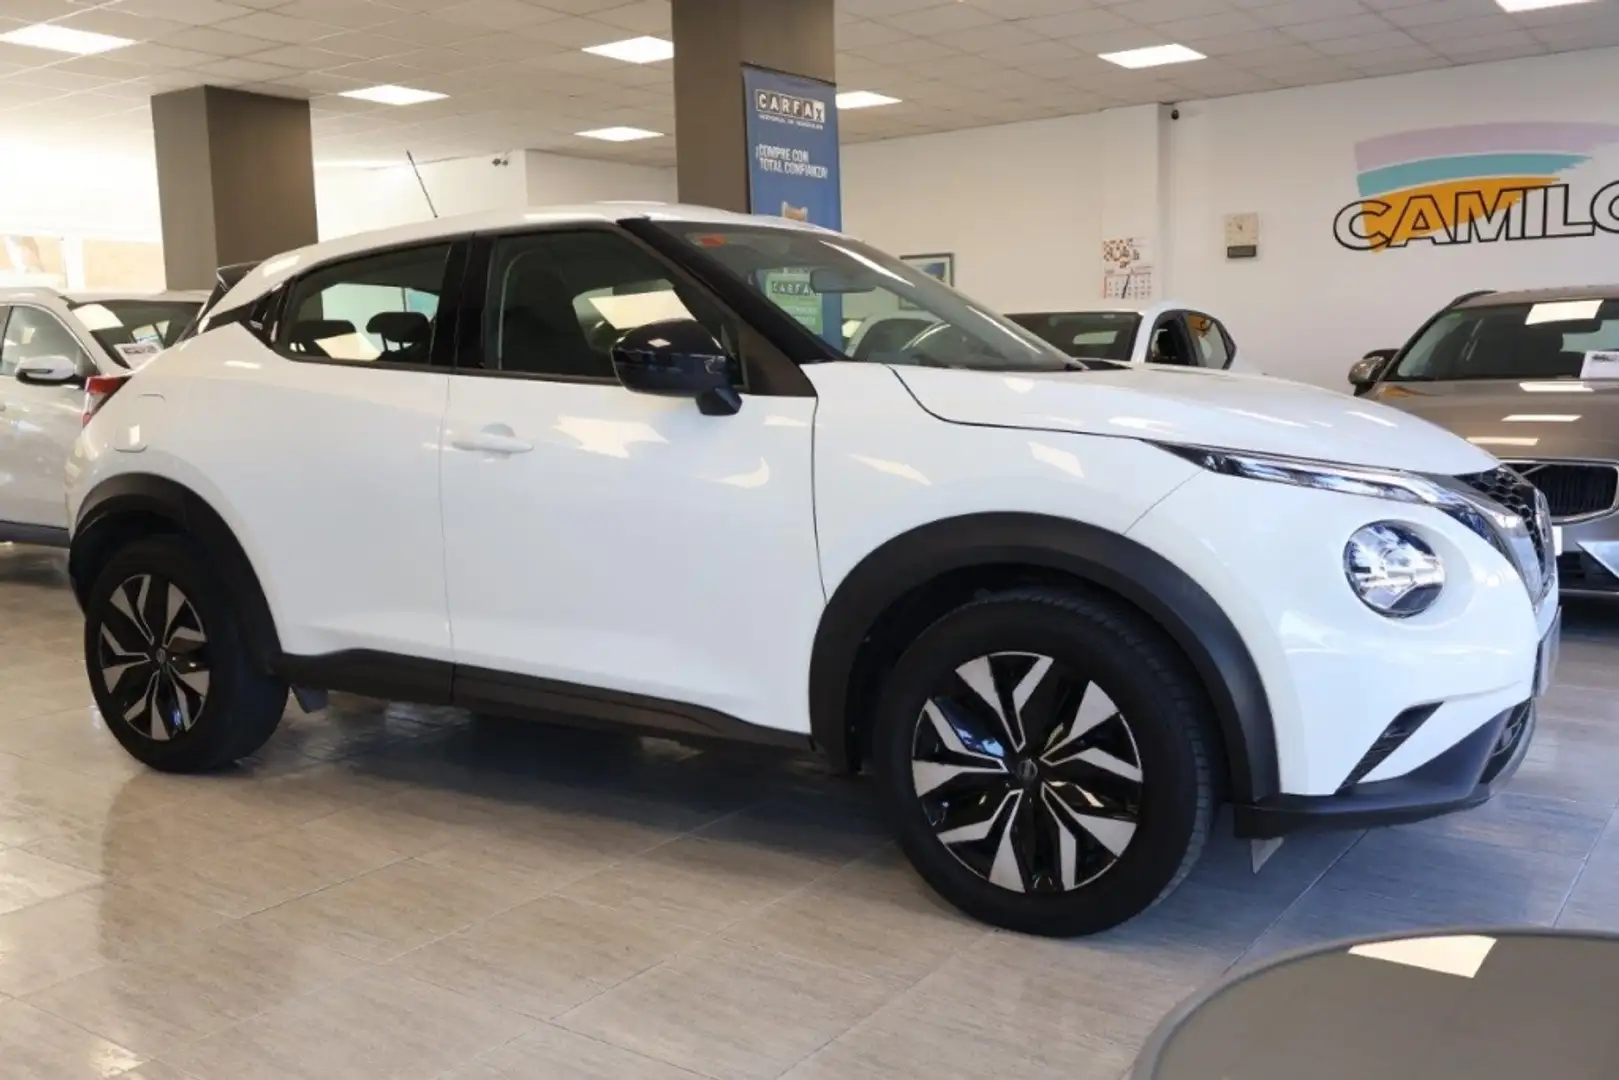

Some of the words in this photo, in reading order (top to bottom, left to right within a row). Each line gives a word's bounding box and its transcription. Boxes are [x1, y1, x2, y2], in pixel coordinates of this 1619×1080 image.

[757, 90, 824, 122] CARFAX
[791, 148, 809, 163] CON
[759, 158, 783, 173] TOTAL
